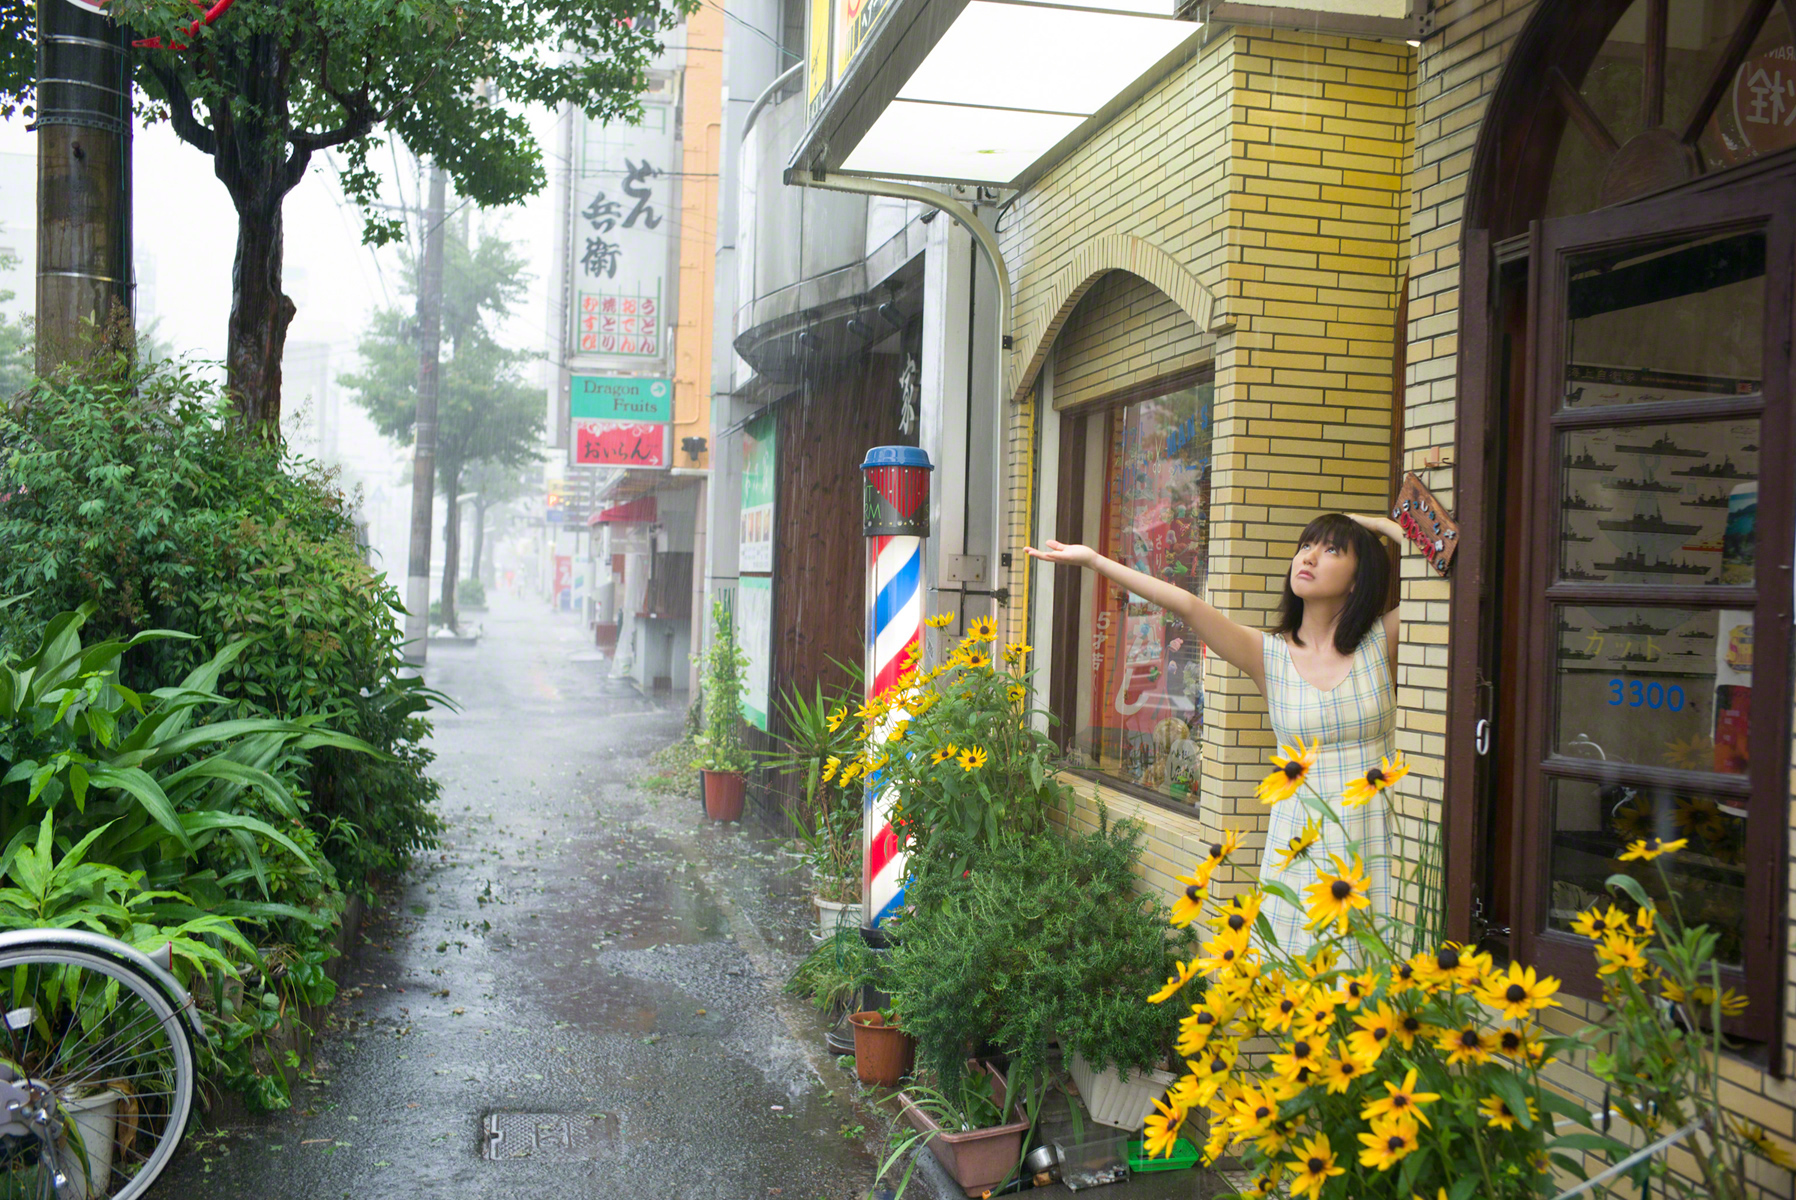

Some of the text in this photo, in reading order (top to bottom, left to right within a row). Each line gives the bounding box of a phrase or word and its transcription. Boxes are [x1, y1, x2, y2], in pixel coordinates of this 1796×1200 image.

[580, 190, 622, 280] 兵衛
[582, 295, 599, 351] むすび
[620, 298, 637, 353] おでん
[640, 298, 655, 355] うどん
[583, 380, 640, 397] Dragon
[613, 398, 658, 413] Fruits
[584, 437, 651, 461] おいらん
[1584, 629, 1662, 661] カット
[1607, 678, 1685, 713] 3300
